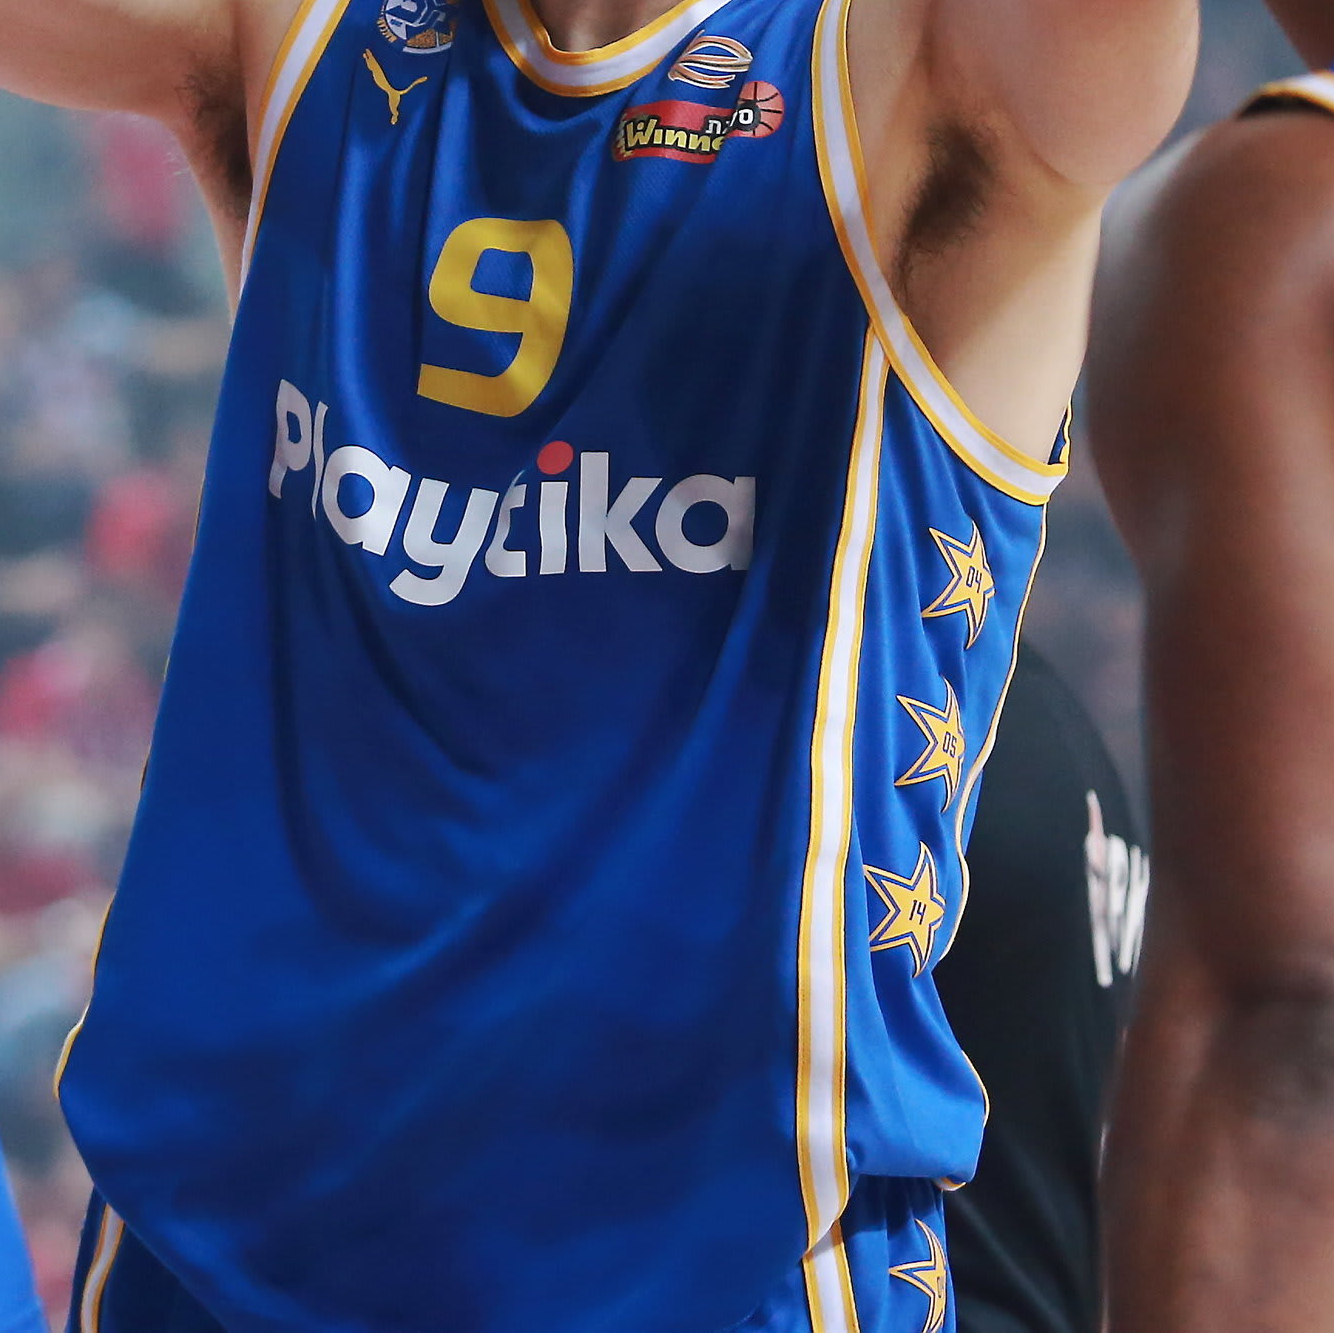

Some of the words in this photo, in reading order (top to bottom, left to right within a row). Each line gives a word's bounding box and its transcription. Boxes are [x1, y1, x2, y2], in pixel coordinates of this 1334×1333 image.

[417, 217, 574, 418] 9
[267, 378, 757, 606] Playtika
[966, 565, 982, 593] 04
[942, 731, 958, 758] 05
[908, 899, 927, 925] 14
